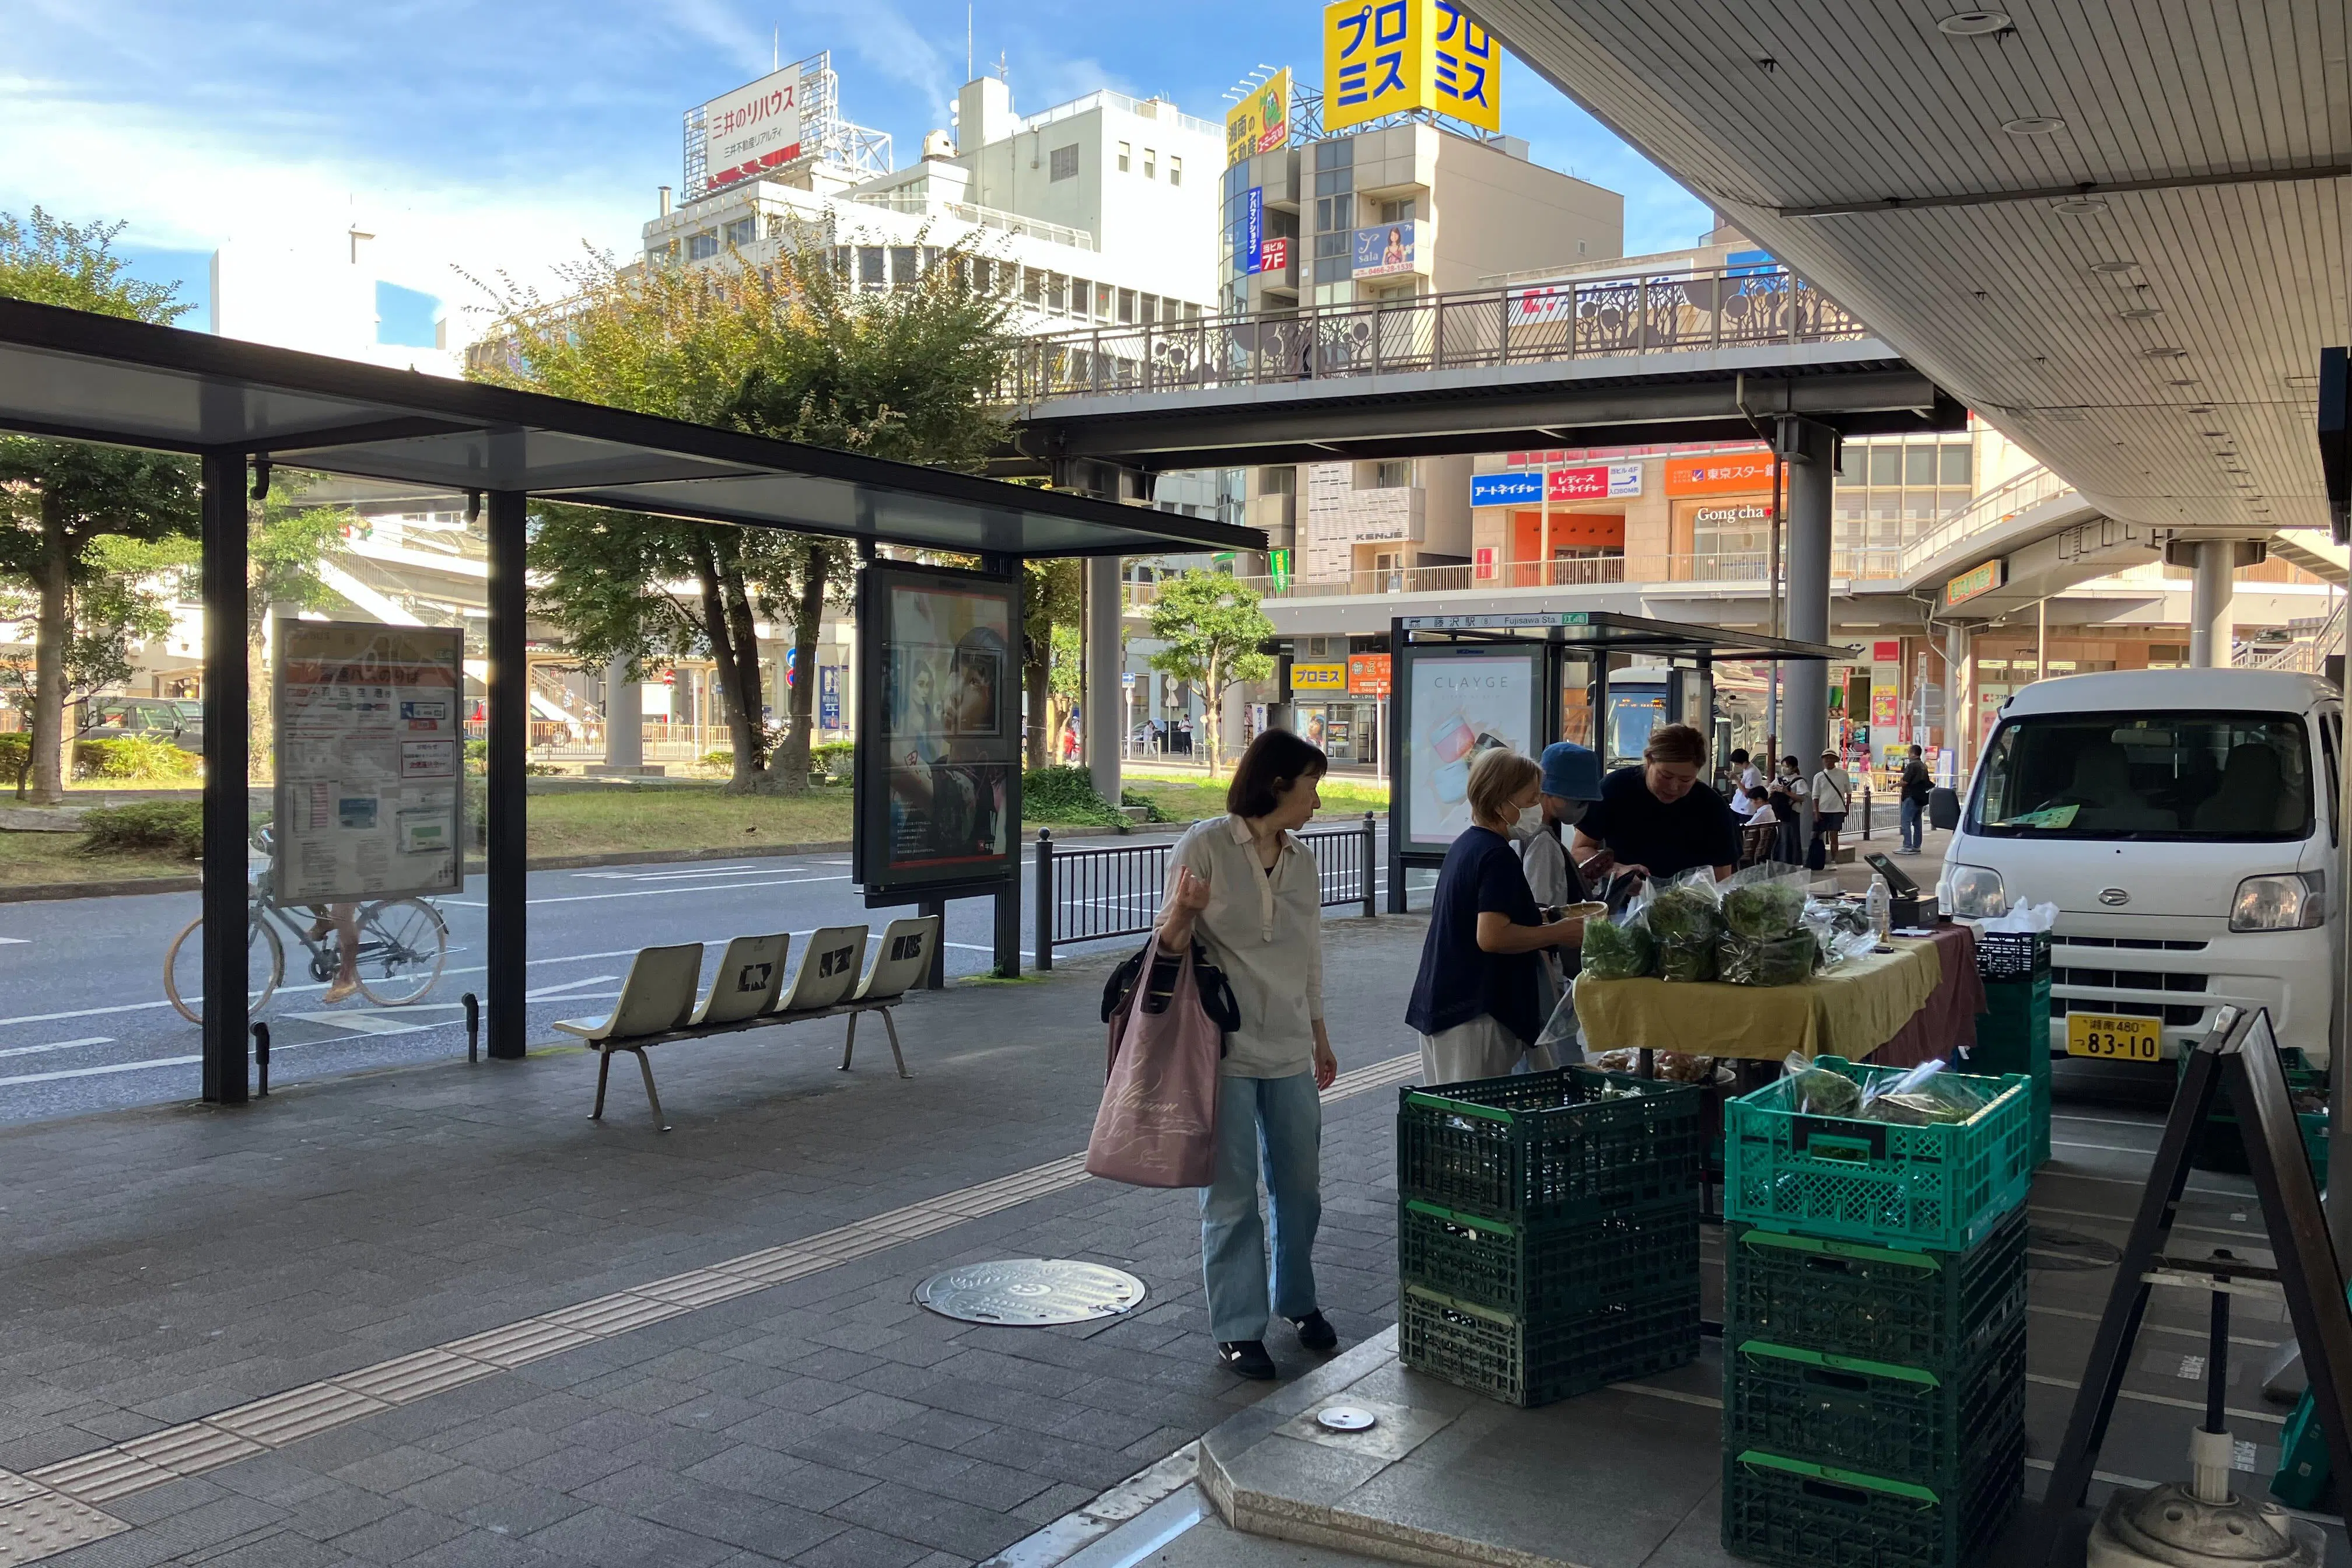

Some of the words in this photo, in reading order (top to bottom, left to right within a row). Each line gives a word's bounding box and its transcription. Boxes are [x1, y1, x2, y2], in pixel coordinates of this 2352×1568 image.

[1338, 2, 1406, 60] プロ
[1338, 50, 1406, 107] ミス
[1434, 50, 1488, 108] ミス
[713, 85, 794, 139] 三井のリハウス
[1228, 114, 1255, 146] 湘南の
[724, 127, 782, 158] 三井不動産リアルティ
[1228, 134, 1256, 166] 不動産
[1263, 242, 1284, 254] 当ビル
[1262, 252, 1284, 270] 7F
[1359, 252, 1378, 262] sala
[1368, 262, 1413, 275] 0466-28-1539
[1558, 474, 1595, 485] レディース
[1475, 482, 1542, 497] アートネイチャー
[1548, 483, 1605, 495] アートネイチャー
[1698, 508, 1735, 523] Gong
[1738, 506, 1764, 518] cha
[1434, 616, 1475, 627] 藤沢駅
[1504, 616, 1540, 625] Fujisawa
[1542, 615, 1558, 624] Sta.
[1296, 670, 1339, 682] プロミス
[1434, 677, 1508, 688] CLAYGE
[2088, 1033, 2155, 1058] 83-10
